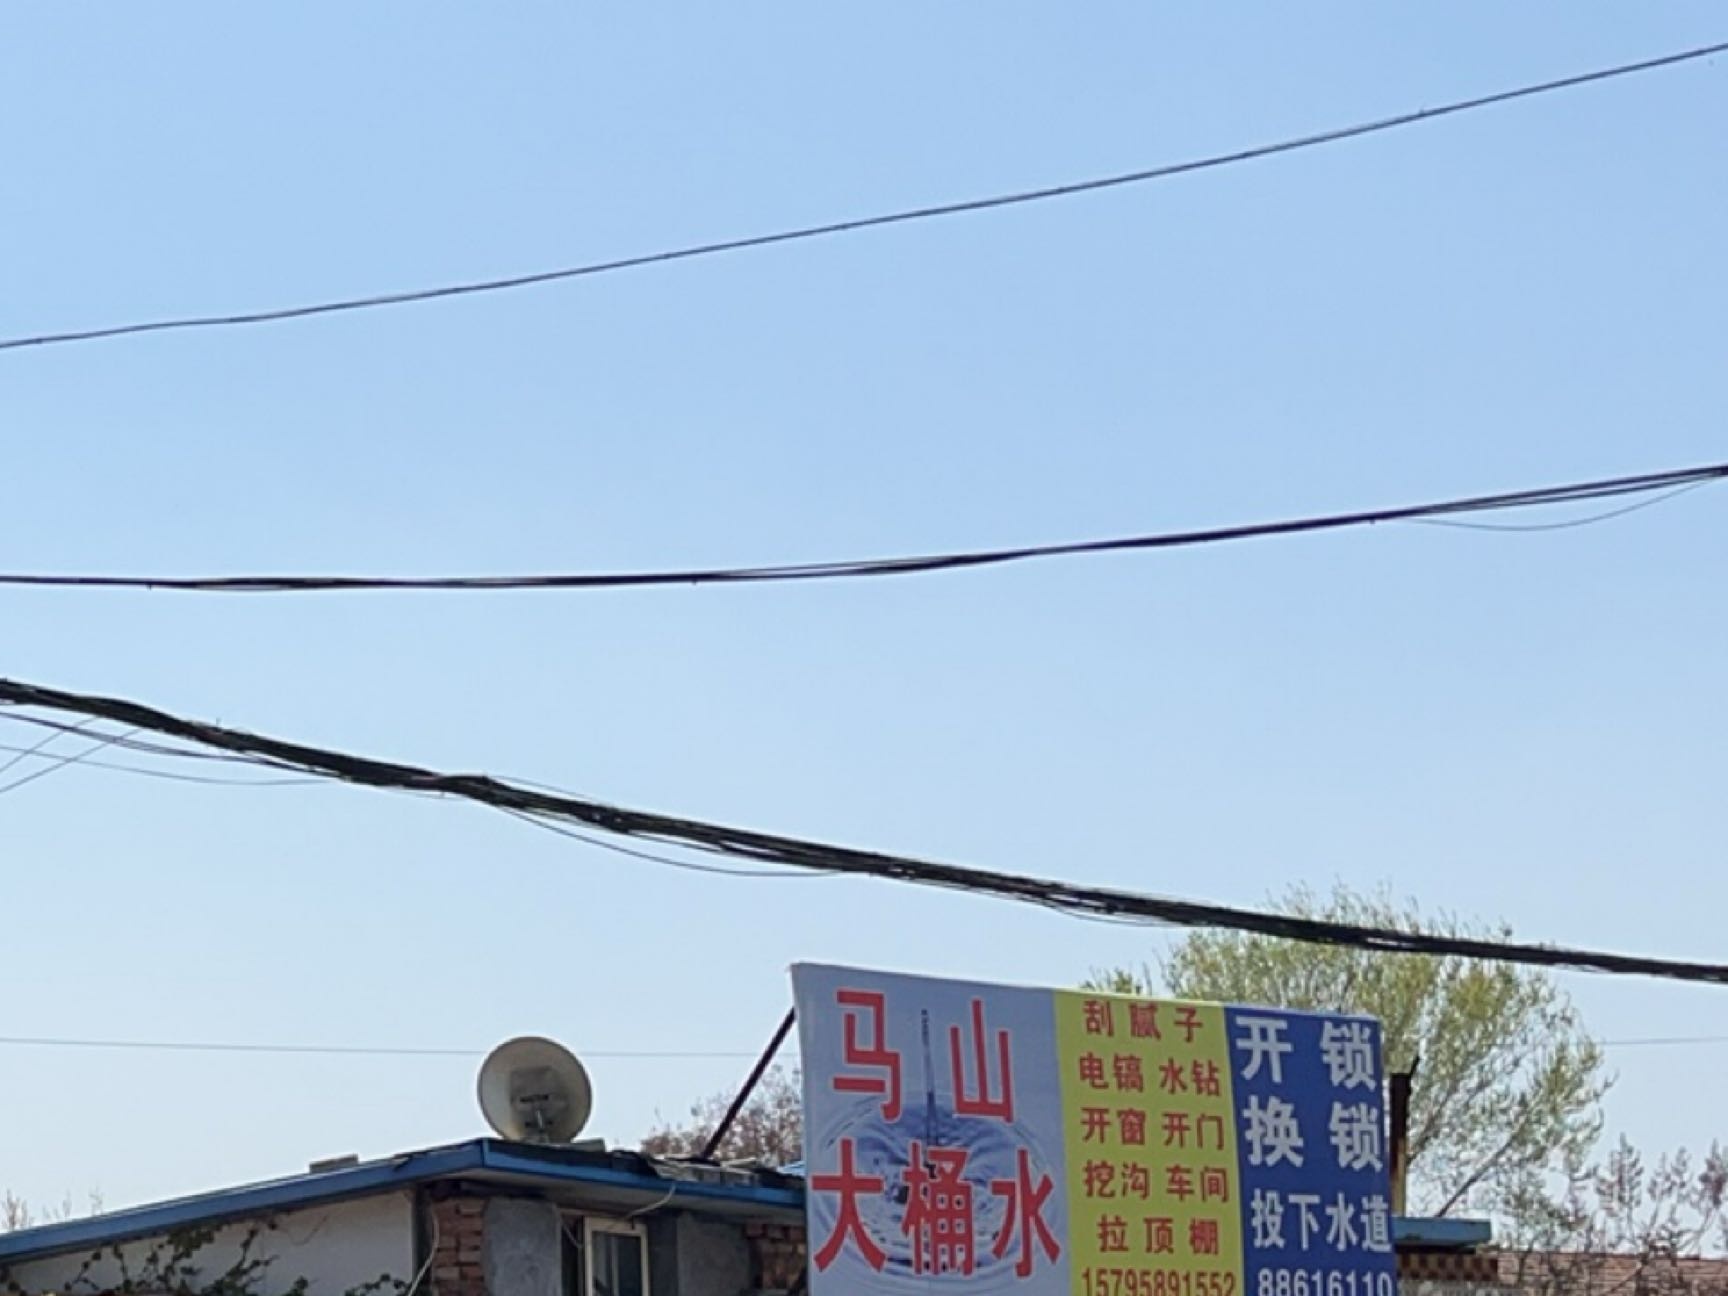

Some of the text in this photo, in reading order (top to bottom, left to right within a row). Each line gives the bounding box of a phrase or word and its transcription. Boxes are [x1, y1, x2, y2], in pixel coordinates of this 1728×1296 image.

[832, 988, 1013, 1122] 马山
[1083, 1000, 1203, 1042] 刮腻子
[1235, 1015, 1376, 1089] 开锁
[1243, 1095, 1382, 1172] 换锁
[811, 1138, 1061, 1278] 大桶水
[1097, 1214, 1219, 1255] 拉顶棚
[1251, 1188, 1392, 1252] 投下水道
